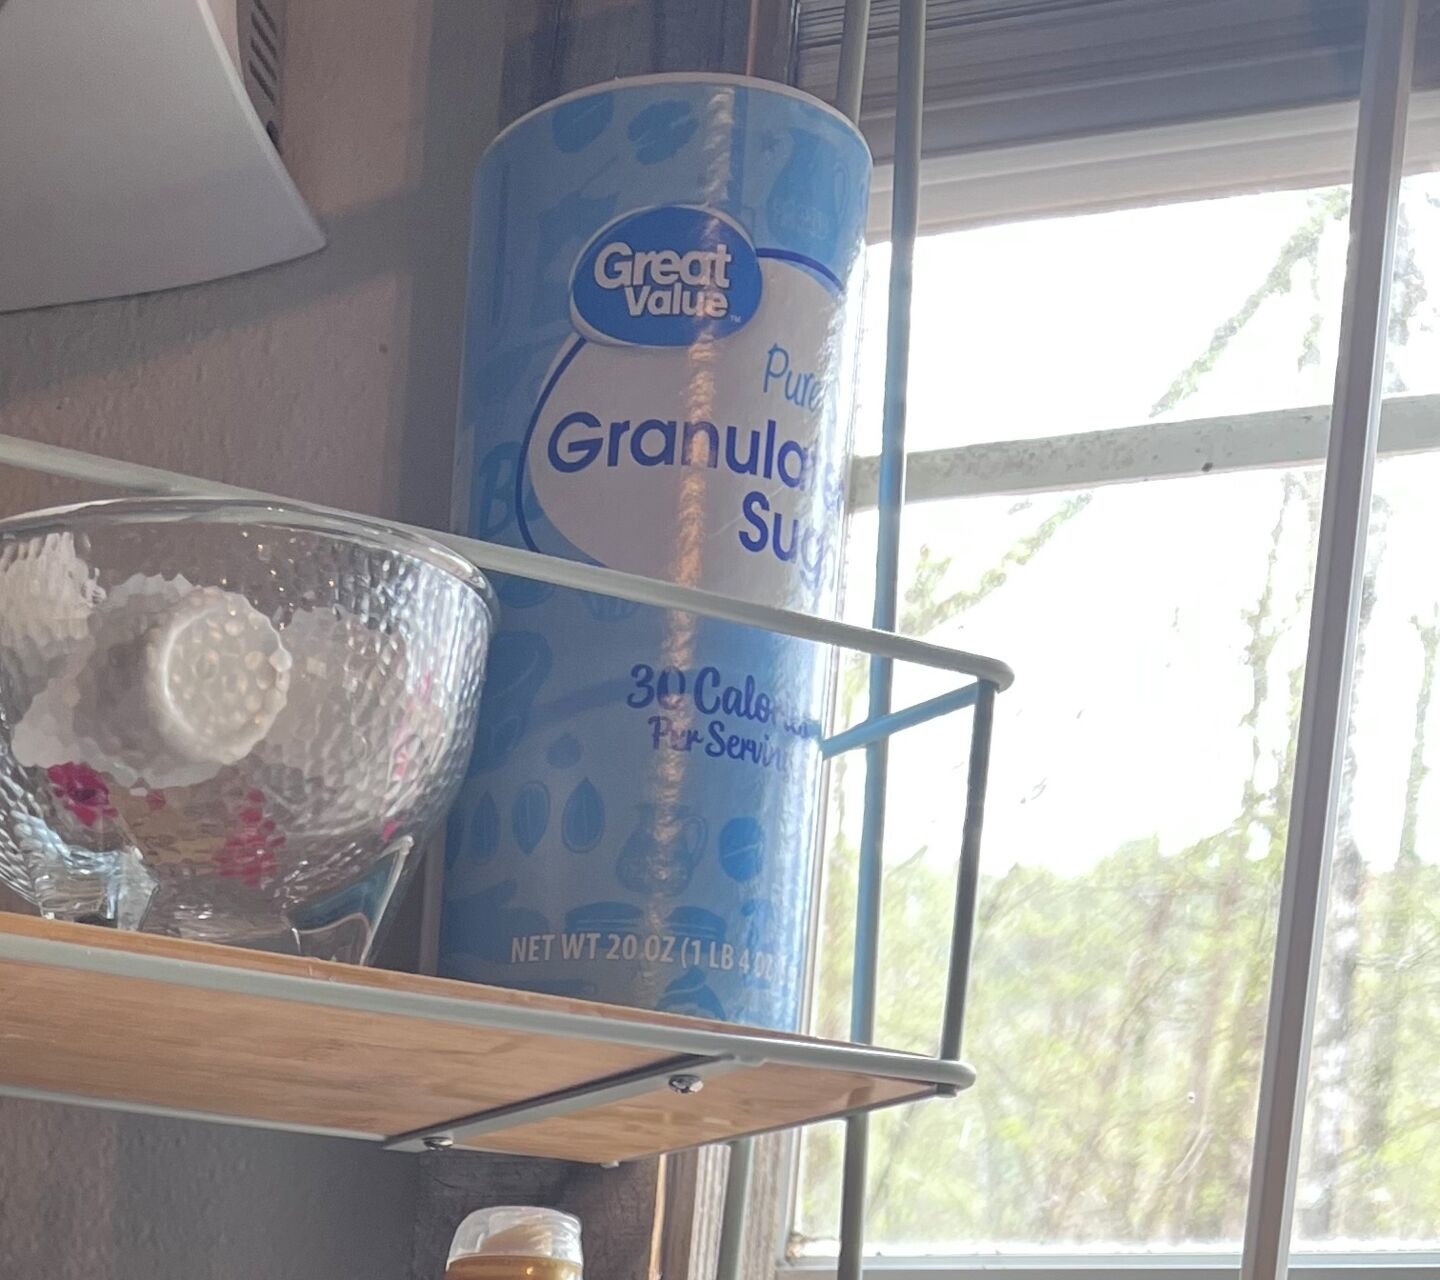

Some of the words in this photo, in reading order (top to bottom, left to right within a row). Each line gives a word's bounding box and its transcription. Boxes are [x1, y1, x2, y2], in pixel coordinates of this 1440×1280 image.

[593, 241, 732, 290] Great
[624, 281, 730, 318] Value
[627, 664, 686, 711] 30
[511, 934, 555, 962] NET
[559, 932, 601, 960] WT
[606, 934, 636, 960] 20
[644, 935, 675, 963] OZ
[709, 941, 734, 971] LB
